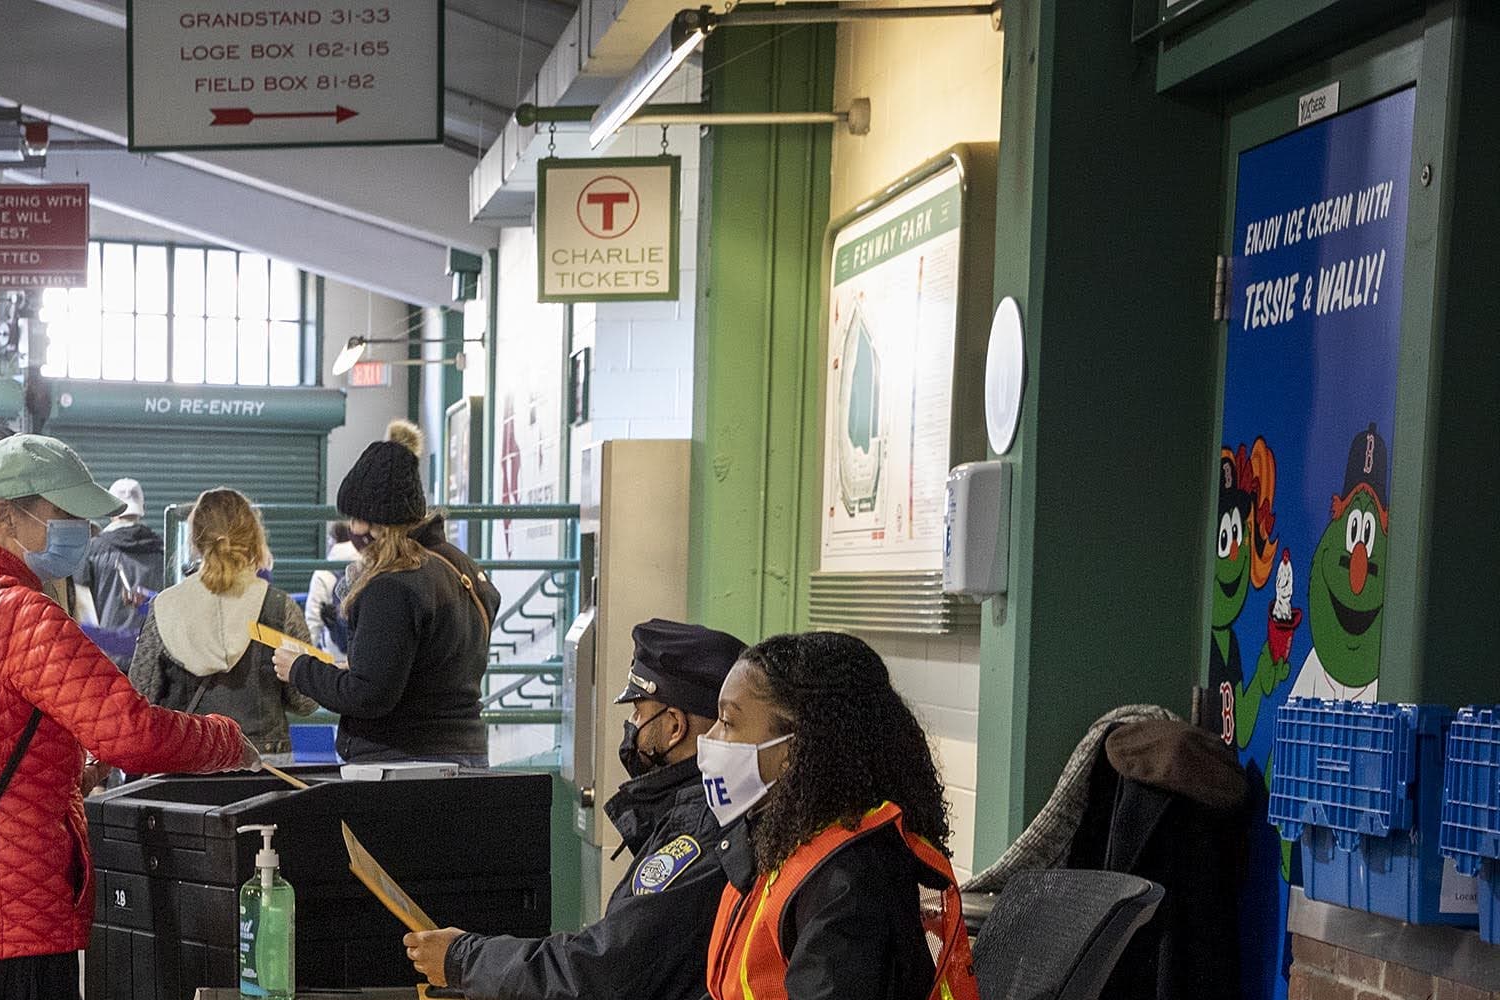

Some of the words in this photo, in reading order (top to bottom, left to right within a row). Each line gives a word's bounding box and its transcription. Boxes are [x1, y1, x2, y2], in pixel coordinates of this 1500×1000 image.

[179, 10, 322, 28] GRANDSTAND
[330, 9, 391, 24] 31-33
[180, 45, 240, 61] LOGE
[250, 43, 295, 59] BOX
[307, 41, 390, 57] 162-165
[194, 77, 254, 93] FIELD
[263, 75, 308, 91] BOX
[316, 74, 375, 90] 81-82
[46, 195, 82, 207] WITH
[16, 211, 51, 223] WILL
[587, 193, 629, 230] T
[1244, 214, 1283, 256] ENJOY
[1283, 206, 1306, 246] ICE
[1306, 193, 1354, 240] CREAM
[1355, 180, 1393, 226] WITH
[853, 226, 897, 269] FENWAY
[900, 208, 932, 245] PARK
[551, 247, 663, 265] CHARLIE
[556, 270, 660, 288] TICKETS
[1243, 272, 1300, 331] TESSIE
[1302, 275, 1313, 311] &
[1315, 248, 1386, 316] WALLY!
[144, 397, 171, 413] NO
[179, 398, 266, 416] RE-ENTRY
[1220, 681, 1235, 745] B
